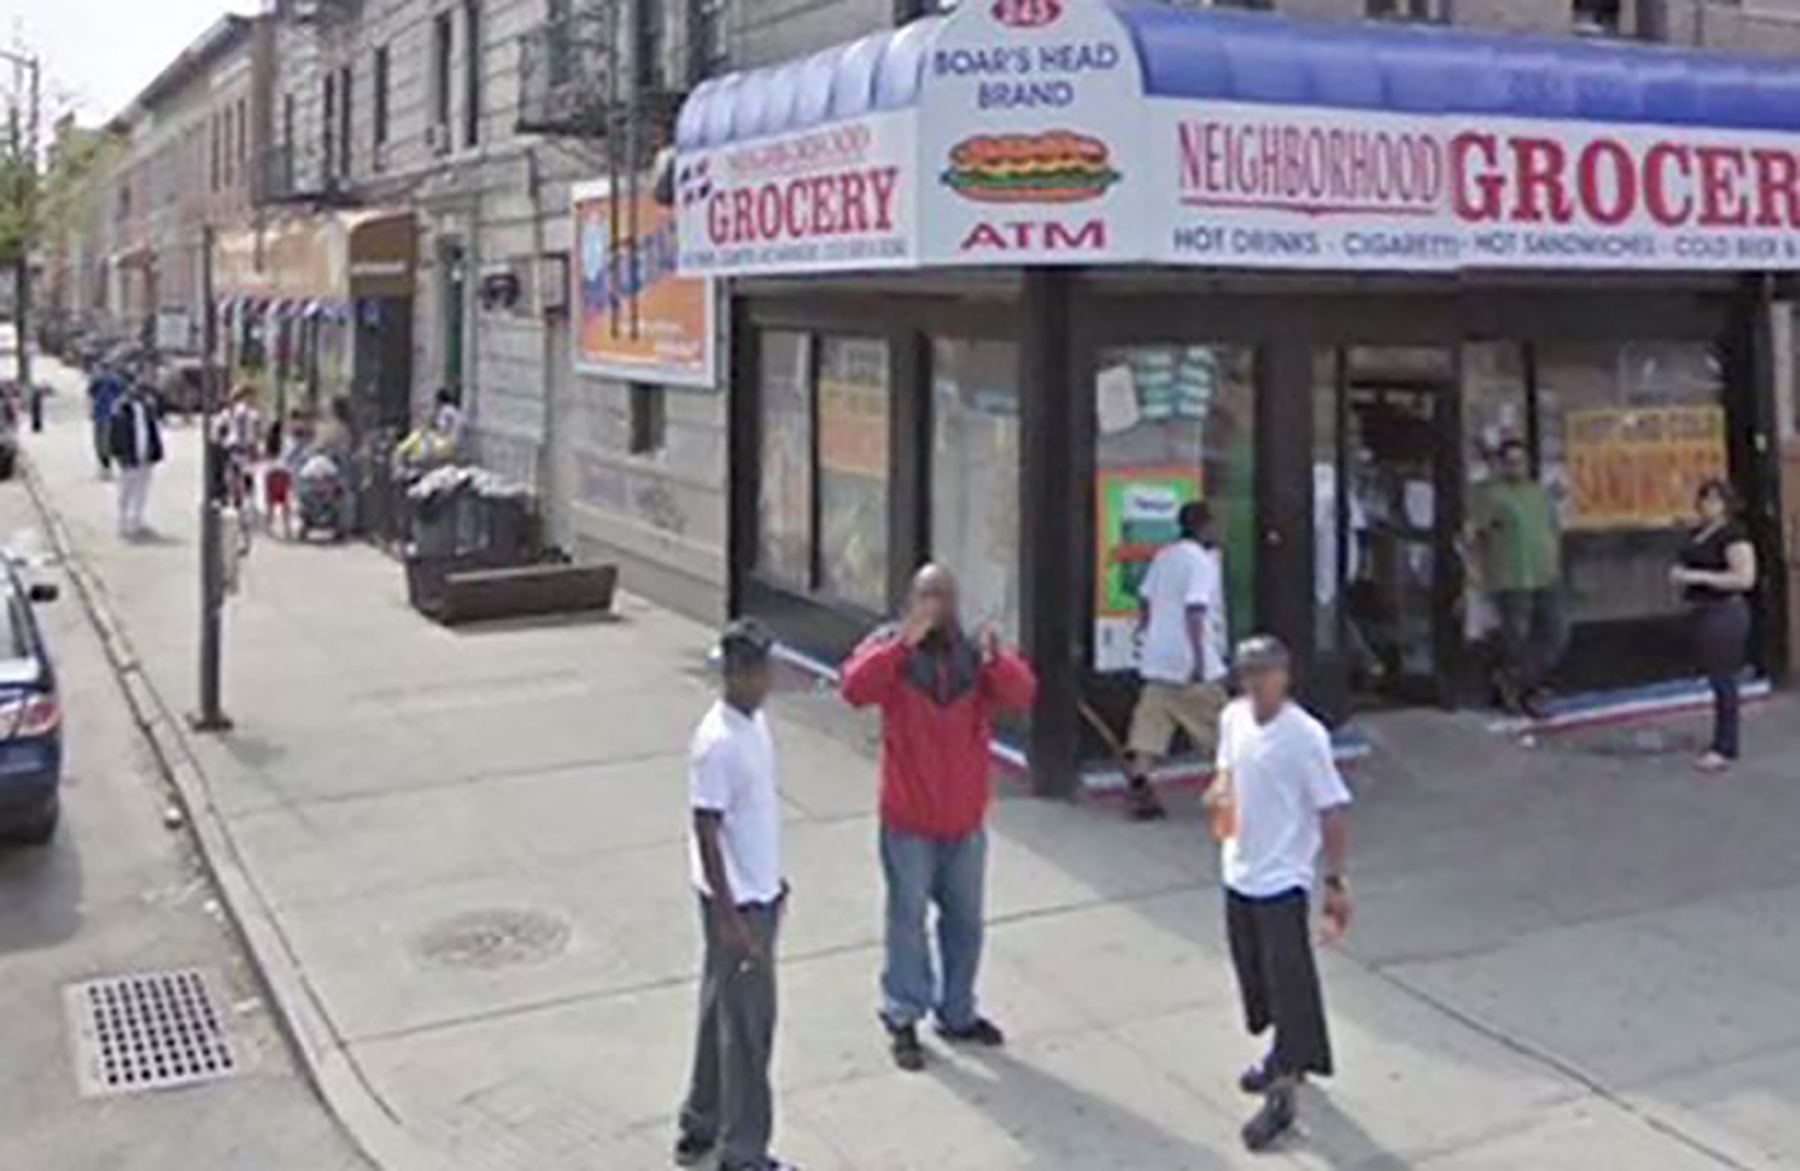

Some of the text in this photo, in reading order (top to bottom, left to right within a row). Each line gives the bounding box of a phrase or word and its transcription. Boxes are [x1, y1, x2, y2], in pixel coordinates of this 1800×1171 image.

[935, 43, 1119, 75] BOAR'S HEAD
[977, 80, 1074, 109] BRAND
[1177, 121, 1800, 228] NEIGHBORHOOD GROCER
[707, 166, 899, 246] GROCERY
[960, 221, 1106, 249] ATM
[1173, 226, 1225, 251] HOT
[1230, 228, 1320, 255] DRINKS
